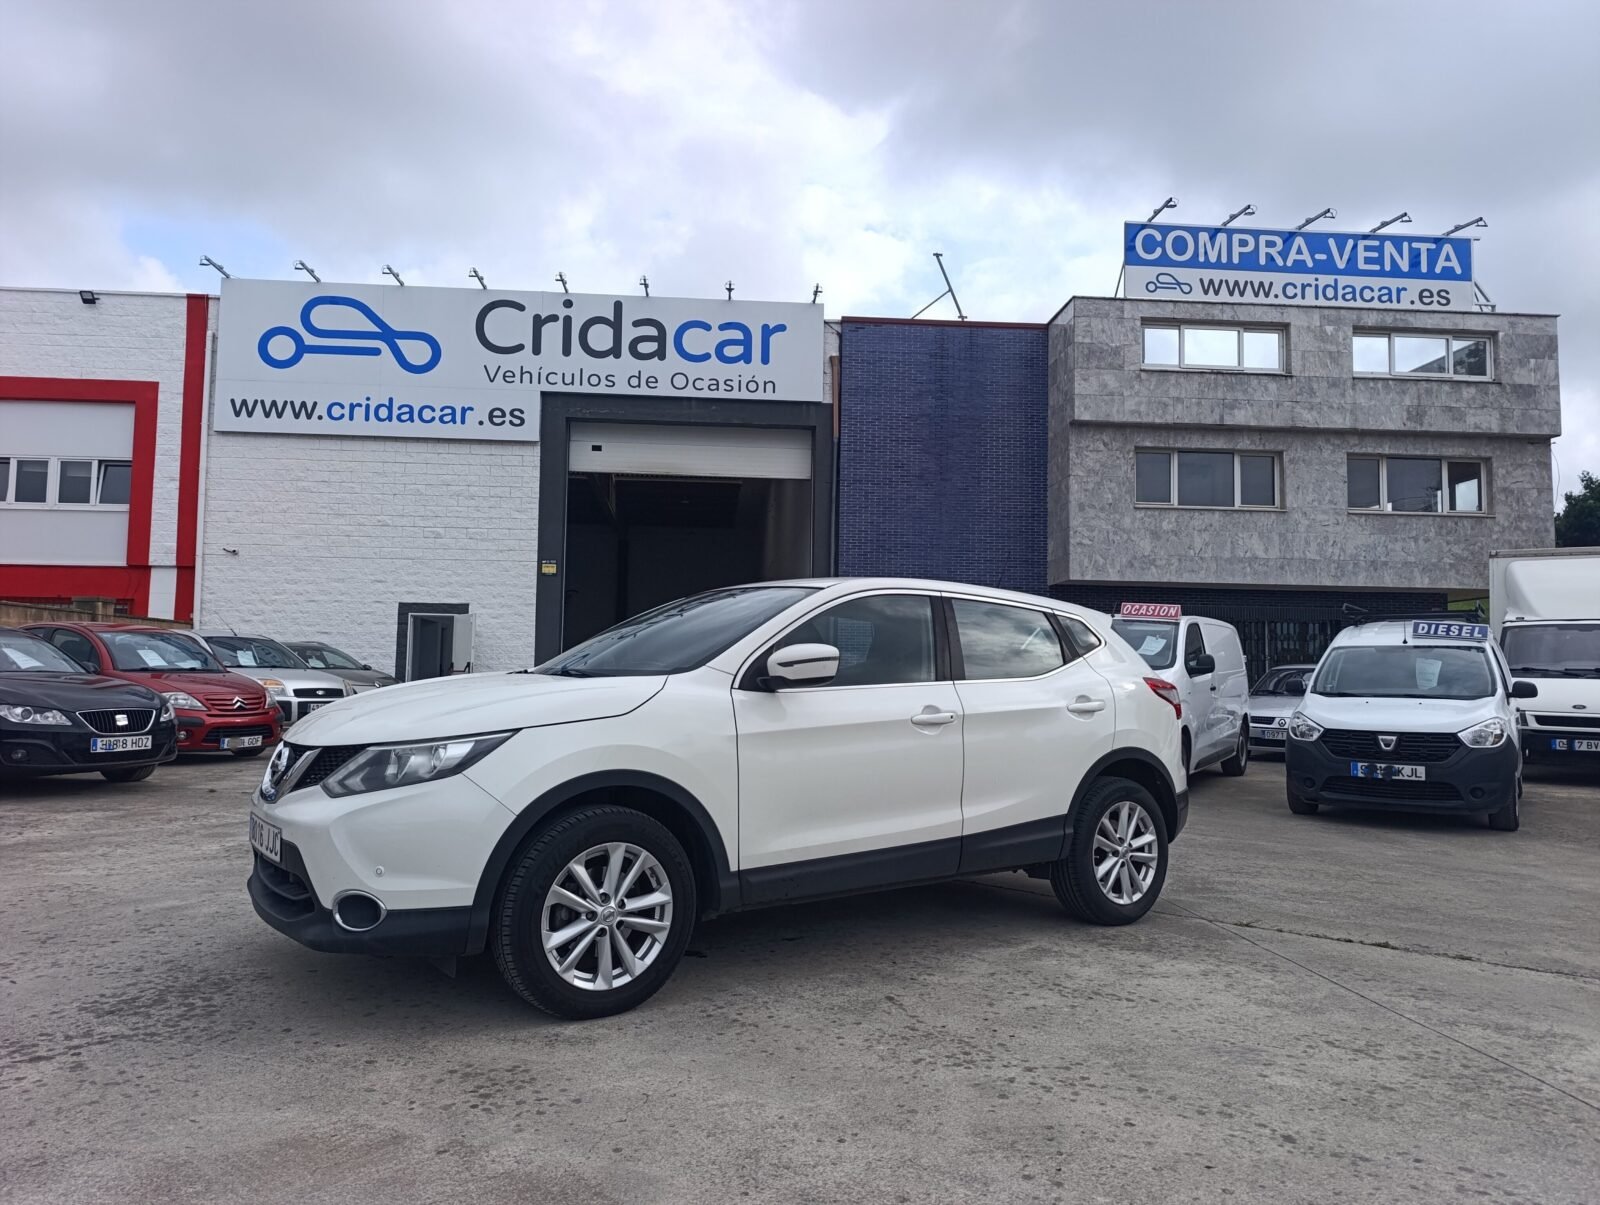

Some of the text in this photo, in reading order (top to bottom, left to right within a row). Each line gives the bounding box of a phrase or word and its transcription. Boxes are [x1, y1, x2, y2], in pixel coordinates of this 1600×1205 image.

[1134, 228, 1463, 275] COMPRA-VENTA
[1199, 277, 1451, 307] www.cridacar.es
[475, 298, 788, 366] Cridacar
[483, 364, 777, 394] Vehículos de Ocasión
[230, 396, 526, 428] www.cridacar.es
[1123, 604, 1178, 617] OCASION
[1417, 623, 1483, 638] DIESEL
[131, 737, 150, 749] HDZ
[1397, 766, 1423, 779] KJL
